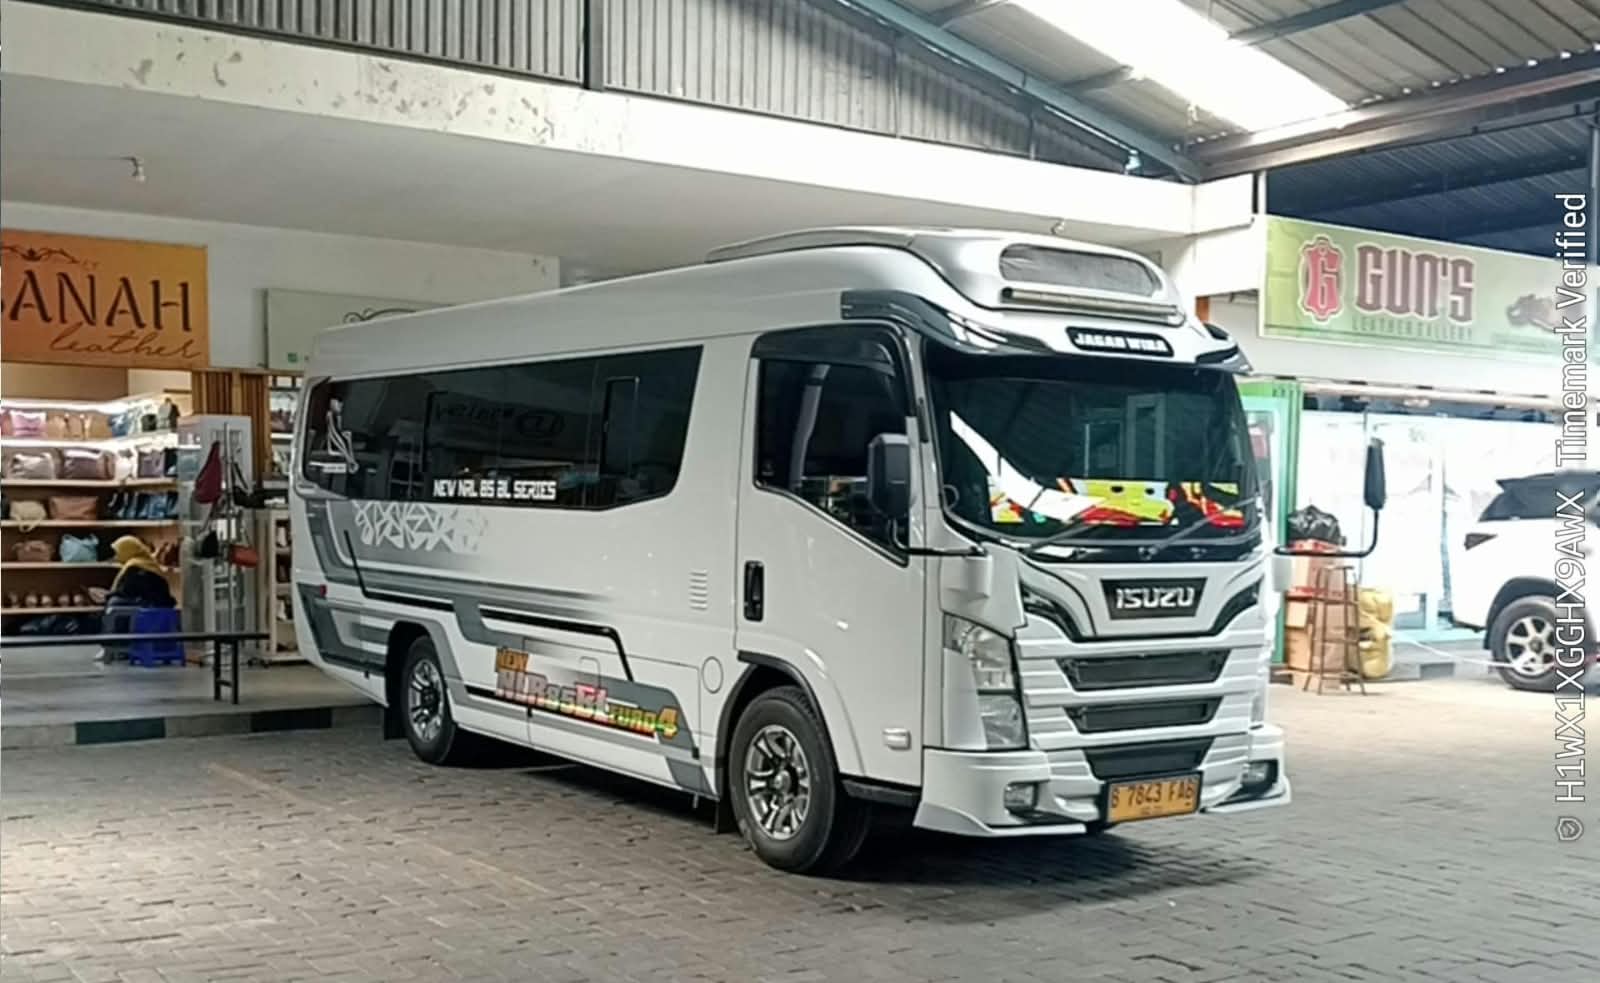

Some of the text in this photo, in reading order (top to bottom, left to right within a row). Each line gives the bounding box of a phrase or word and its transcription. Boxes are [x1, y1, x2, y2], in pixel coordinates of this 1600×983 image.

[1, 268, 193, 332] ANAH
[1356, 244, 1475, 322] GUN'S
[50, 321, 202, 359] leather
[433, 479, 457, 498] NEW
[512, 480, 557, 500] SERIES
[1116, 587, 1195, 608] ISUZU
